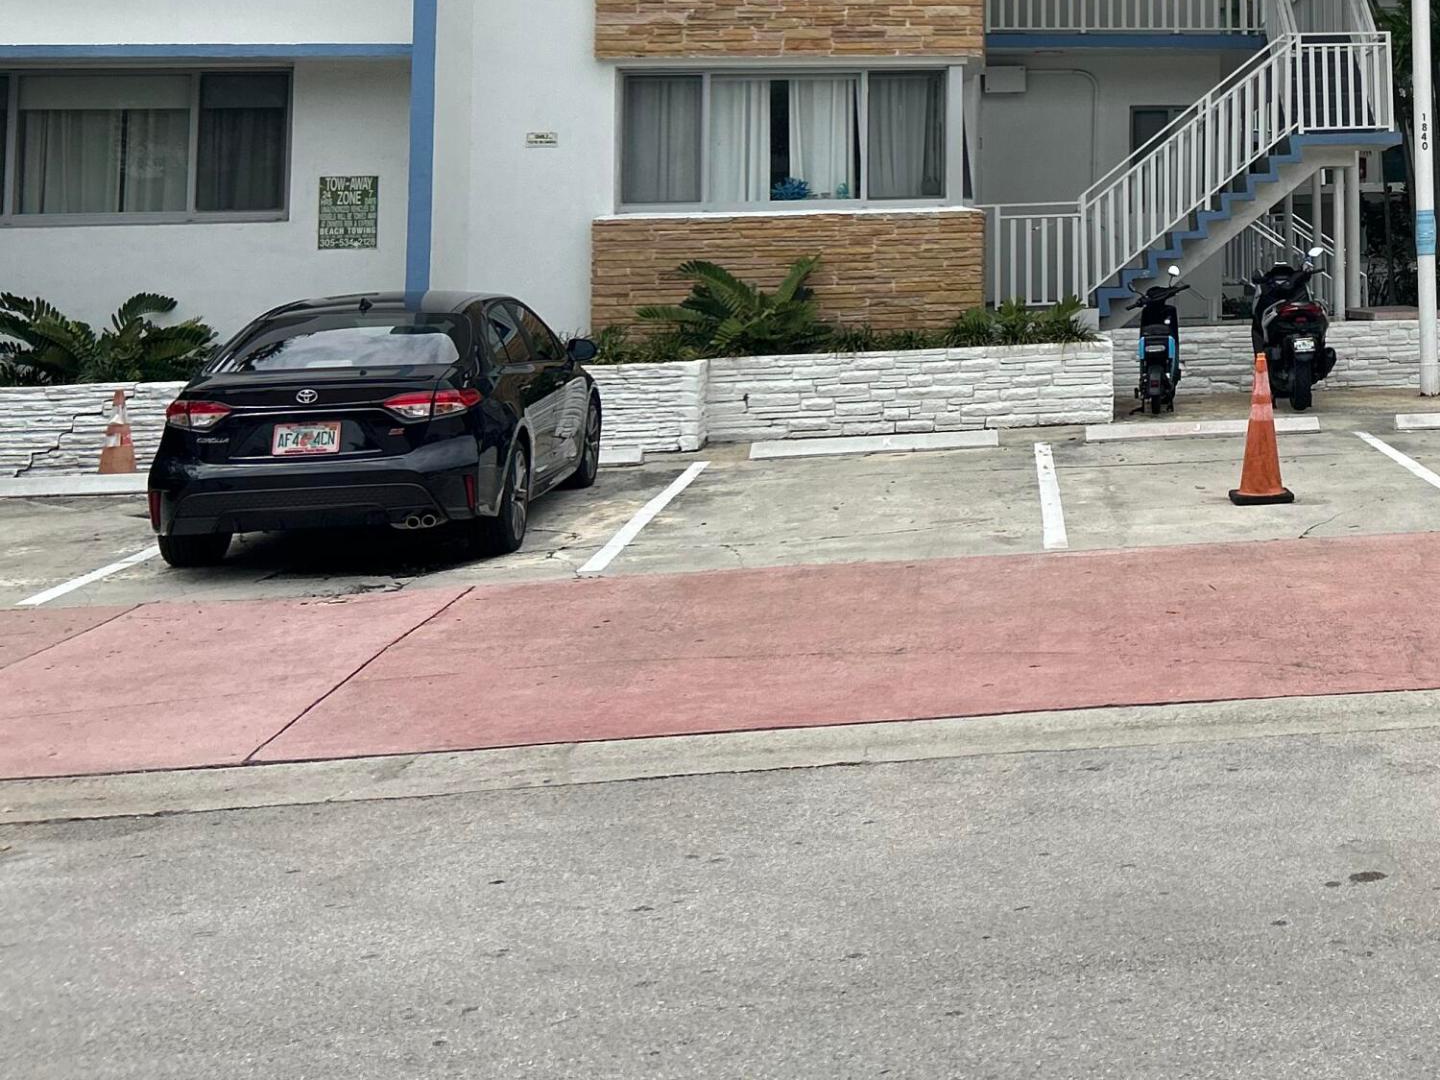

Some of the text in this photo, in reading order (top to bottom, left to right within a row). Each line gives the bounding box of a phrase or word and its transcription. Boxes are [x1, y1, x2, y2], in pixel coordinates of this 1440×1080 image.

[1420, 112, 1429, 151] 1840
[325, 177, 374, 191] TOW-AWAY
[337, 191, 362, 205] ZONE
[319, 227, 345, 235] BEACH
